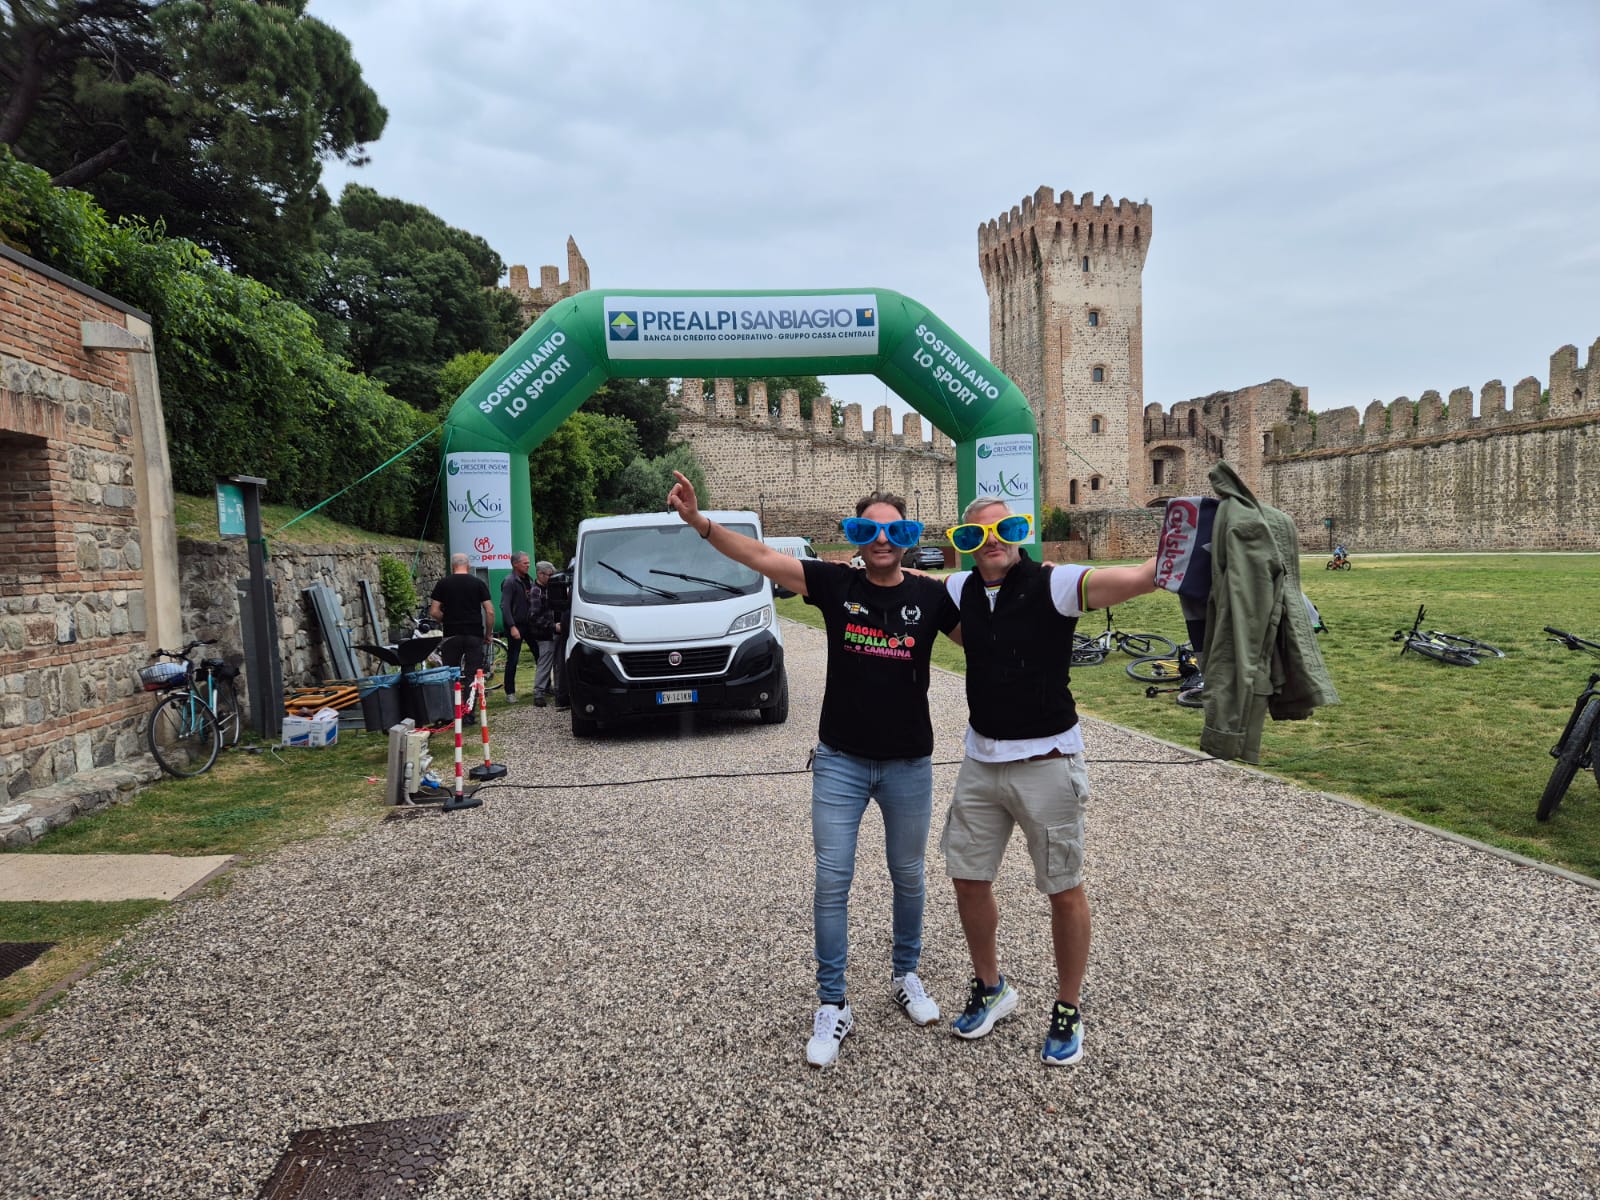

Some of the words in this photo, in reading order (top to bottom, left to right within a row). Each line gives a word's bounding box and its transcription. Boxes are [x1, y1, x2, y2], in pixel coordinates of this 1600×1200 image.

[643, 334, 672, 342] BANCA
[673, 334, 681, 342] DI
[718, 333, 774, 341] COOPERATIVO
[779, 332, 810, 340] GRUPPO
[811, 331, 837, 339] CASSA
[838, 330, 876, 338] CENTRALE
[478, 331, 566, 414] SOSTENIAMO
[912, 347, 934, 368] LO
[932, 365, 978, 406] SPORT
[915, 324, 999, 399] SOSTENIAMO
[504, 396, 527, 418] LO
[525, 353, 571, 399] SPORT
[481, 554, 496, 563] per
[844, 631, 888, 648] PEDALA
[863, 645, 912, 658] CAMMINA
